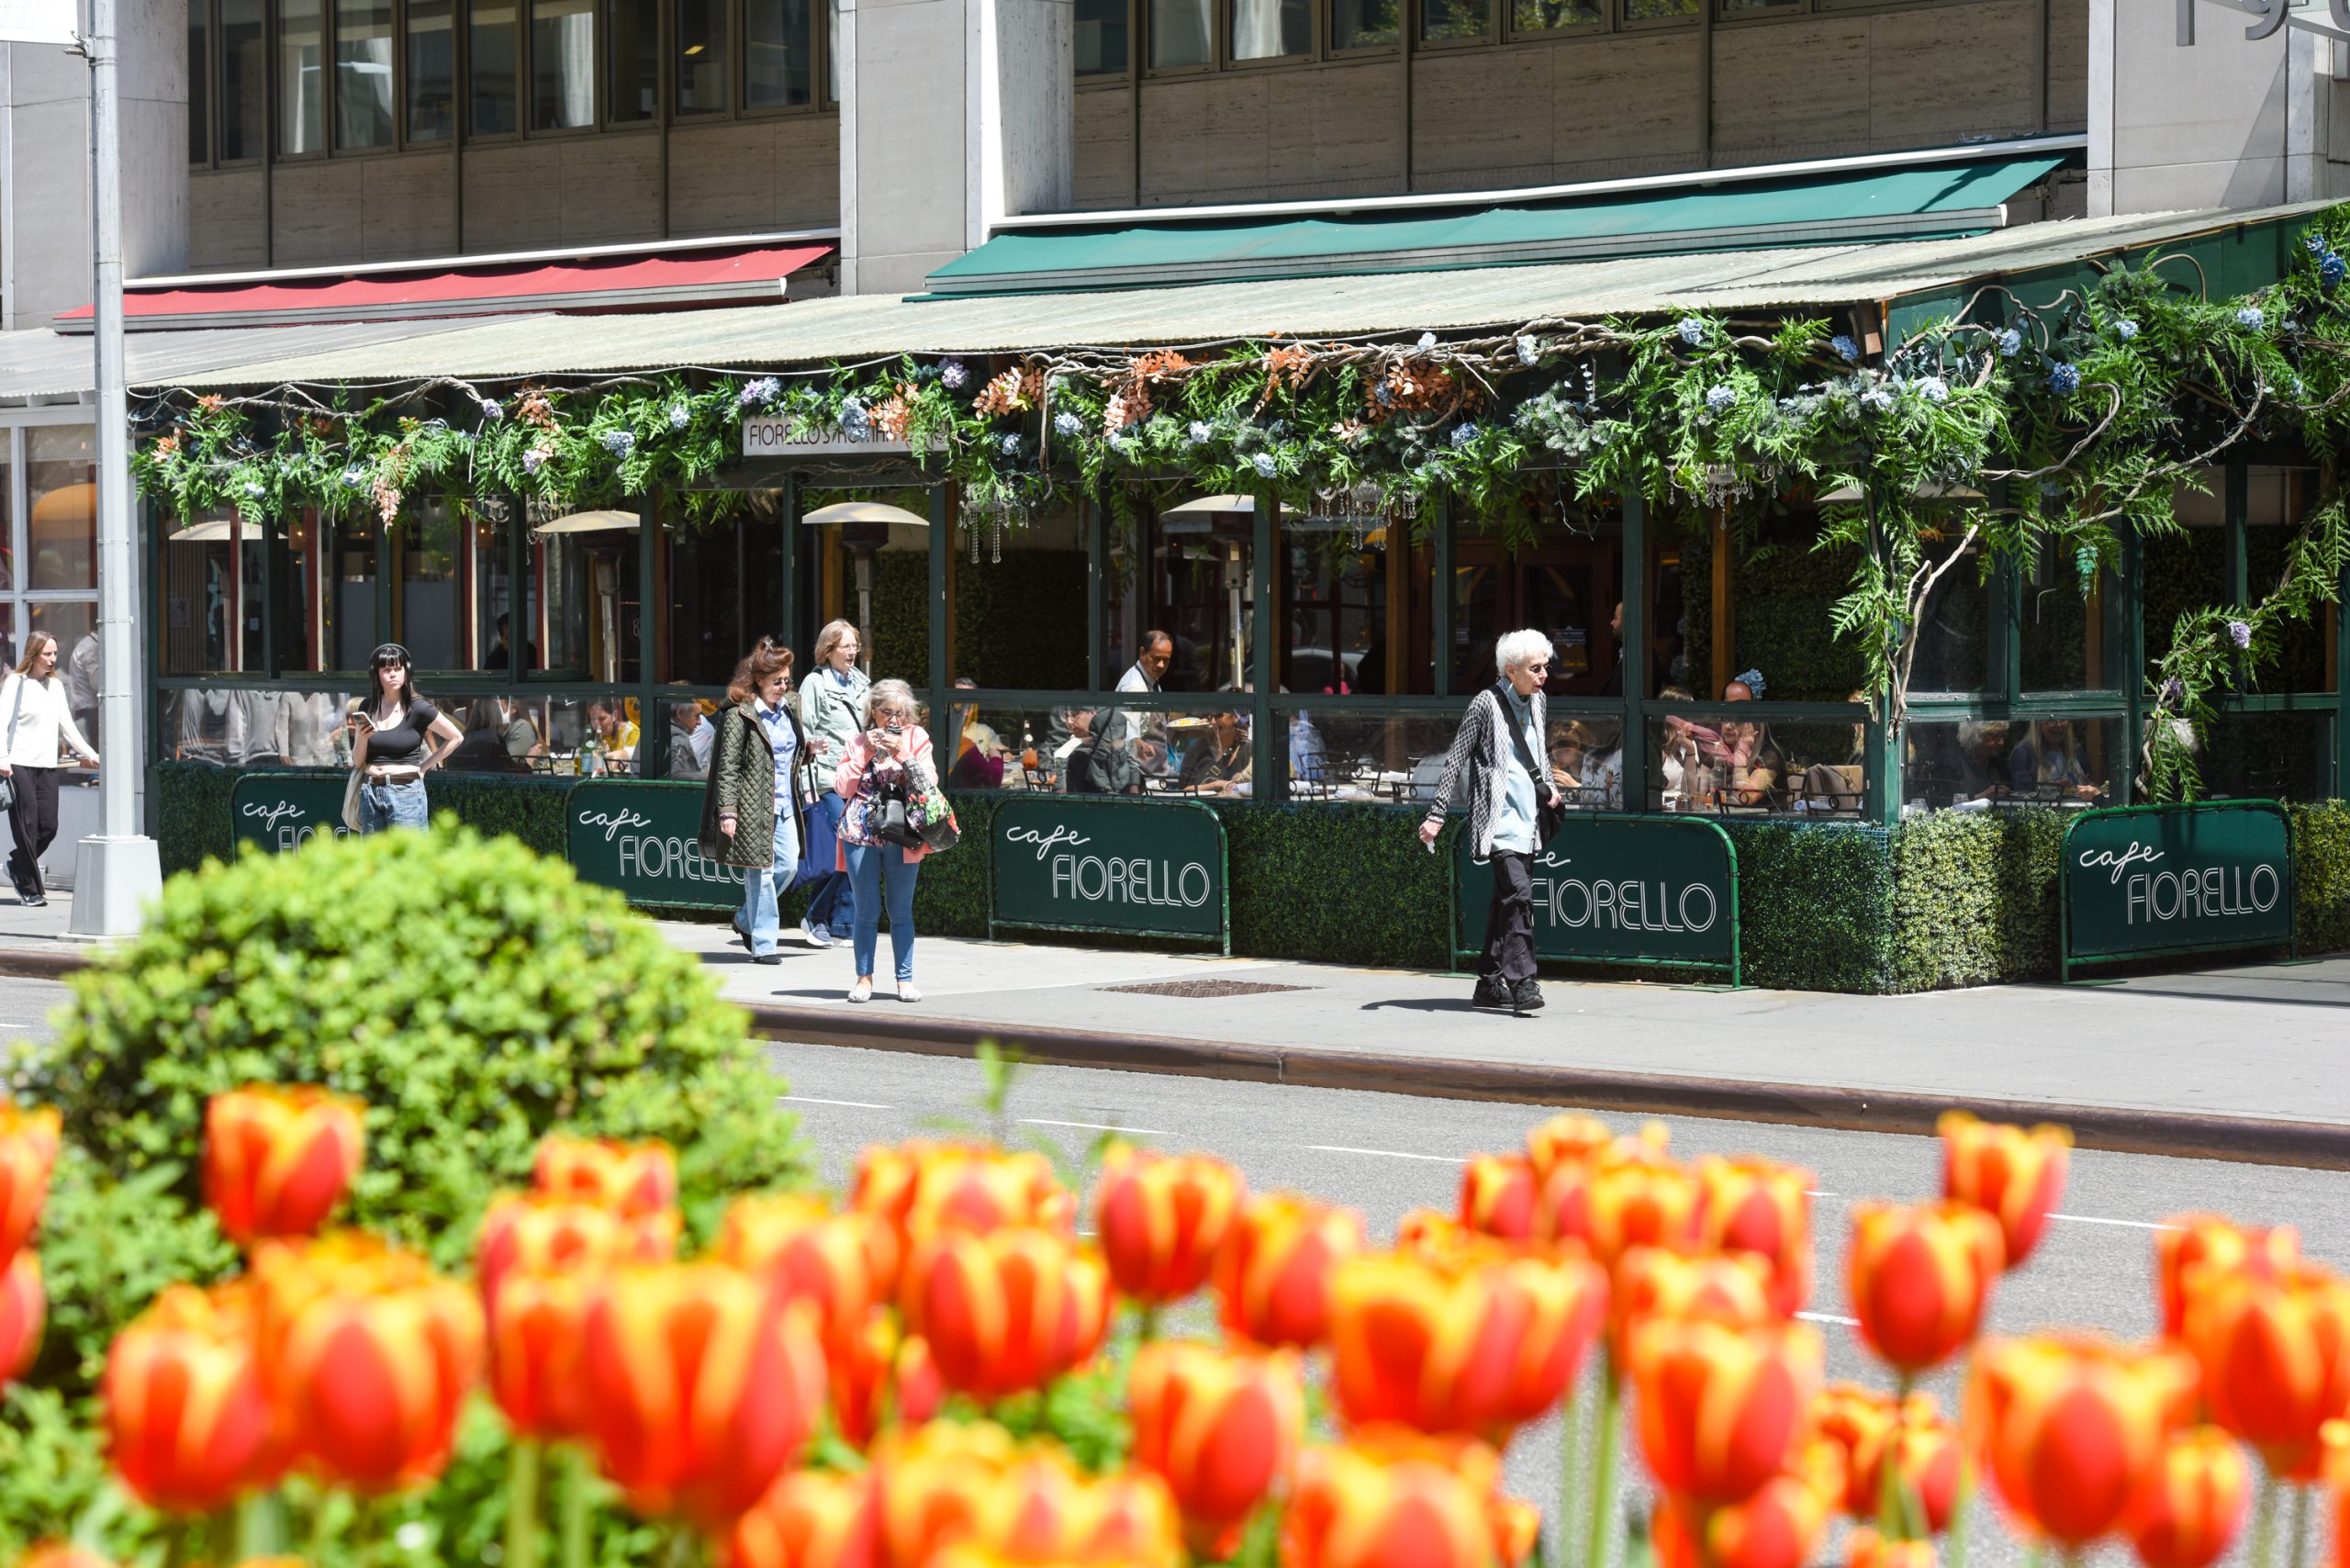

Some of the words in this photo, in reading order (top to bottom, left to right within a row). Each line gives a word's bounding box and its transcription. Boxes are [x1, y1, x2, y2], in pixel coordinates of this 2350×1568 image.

[748, 423, 832, 447] FIORELLOS
[242, 800, 306, 832] cafe
[578, 807, 652, 842] cafe
[619, 834, 746, 885] FIORELL
[1006, 824, 1091, 861] cafe
[2079, 840, 2165, 885] cafe
[1052, 854, 1211, 907] FIORELLO
[2127, 863, 2280, 925] FIORELLO
[1530, 878, 1718, 933] FIORELLO
